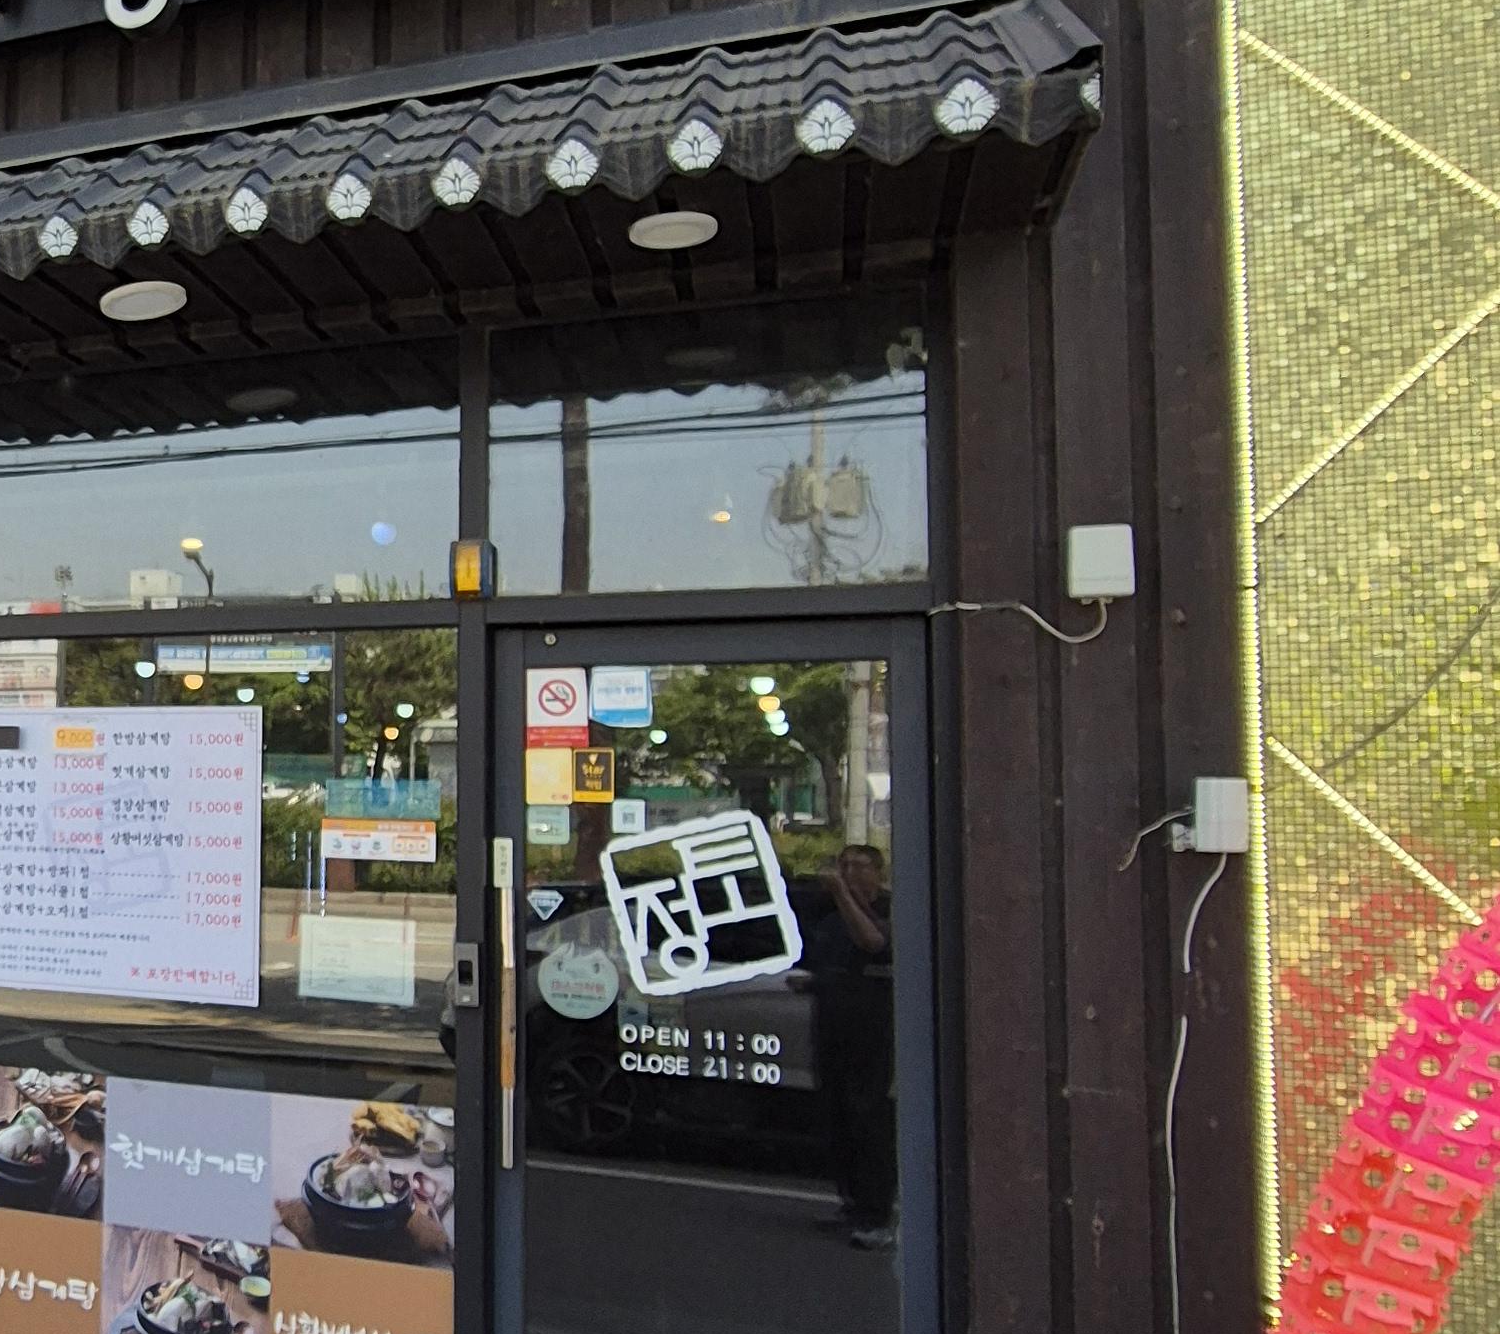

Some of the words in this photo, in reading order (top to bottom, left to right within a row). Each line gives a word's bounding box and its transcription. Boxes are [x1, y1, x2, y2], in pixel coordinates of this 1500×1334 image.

[112, 731, 172, 747] 한방삼계탕
[188, 732, 245, 747] 15,000원
[54, 755, 106, 772] 13,000원
[188, 766, 244, 781] 15,000원
[53, 780, 105, 796] 13,000원
[52, 805, 104, 821] 15,000원
[187, 800, 244, 816] 15,000원
[52, 830, 104, 846] 15,000원
[110, 830, 185, 848] 상황버섯삼계탕
[187, 834, 243, 851] 15,000원
[186, 870, 243, 887] 17,000원
[186, 890, 242, 908] 17,000원
[185, 911, 242, 929] 17,000원
[619, 1022, 690, 1048] OPEN
[619, 1050, 690, 1077] CLOSE
[108, 1132, 268, 1184] 헛개삼계탕
